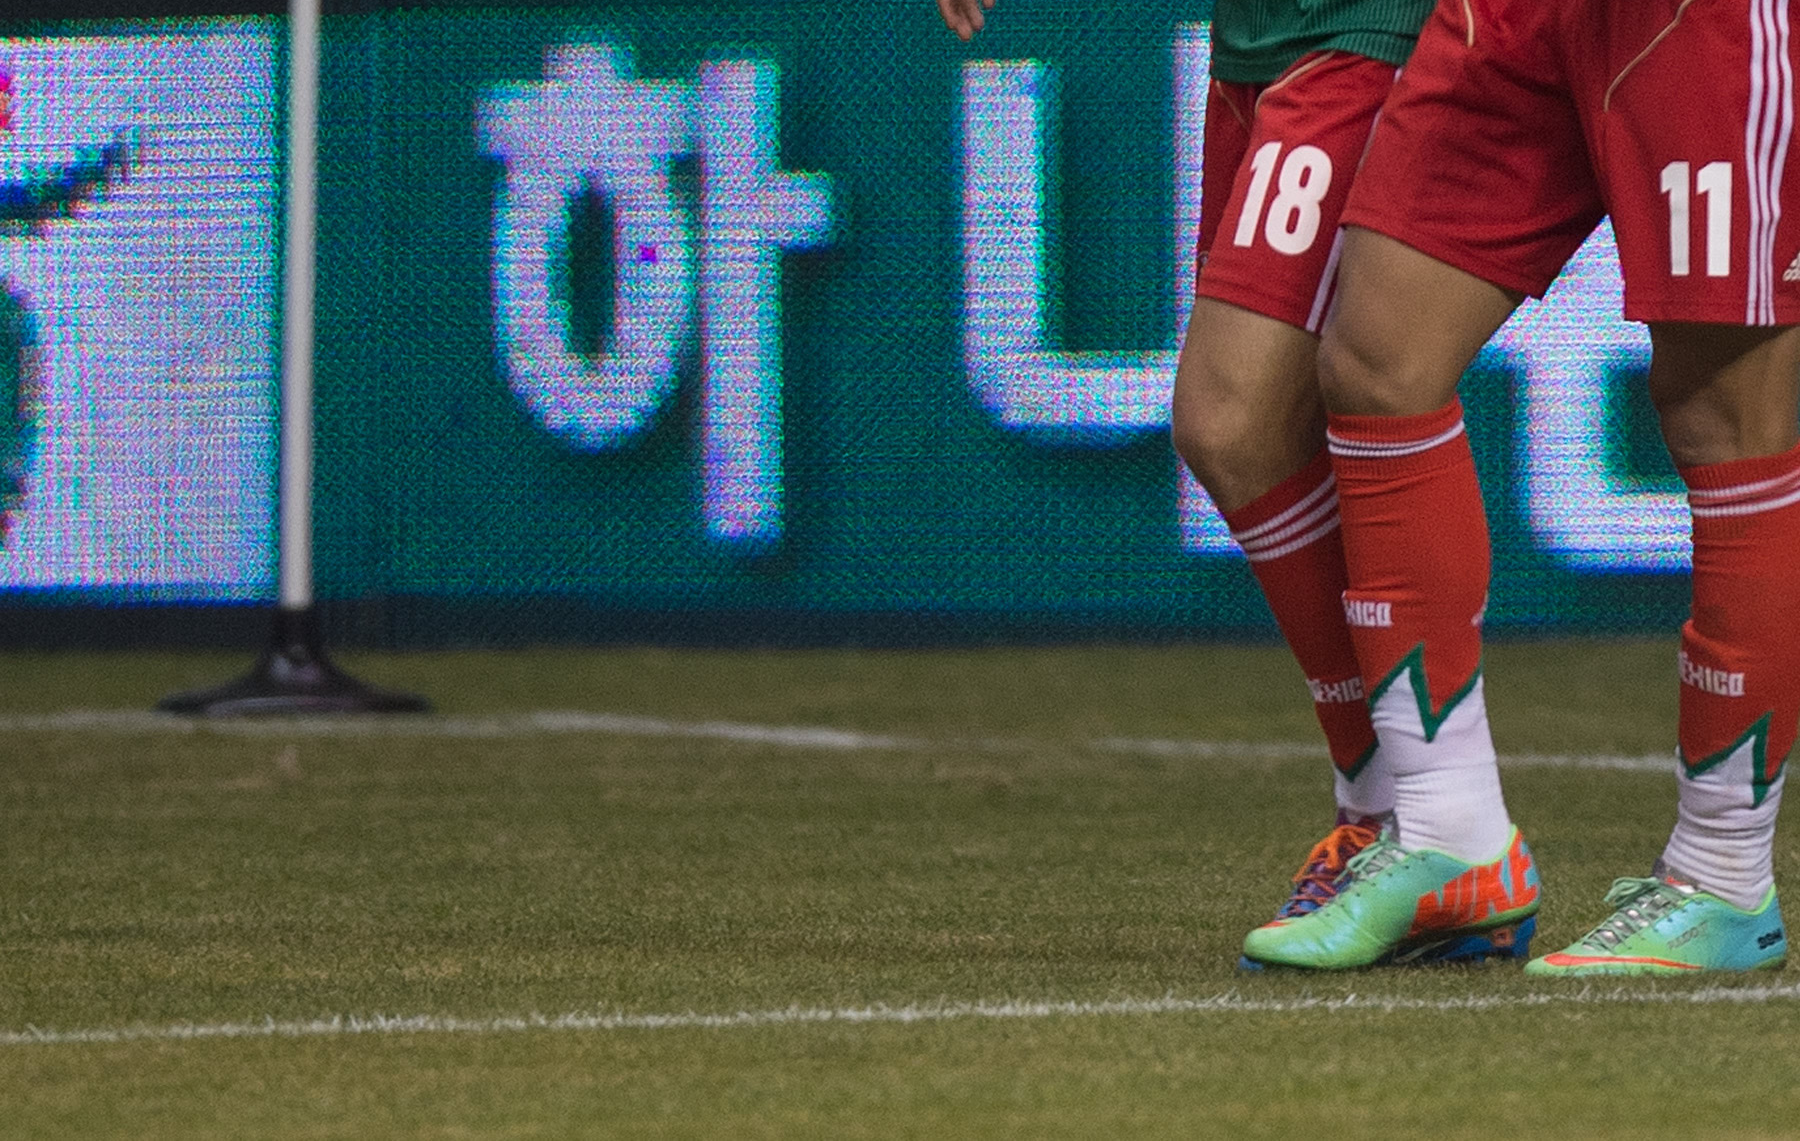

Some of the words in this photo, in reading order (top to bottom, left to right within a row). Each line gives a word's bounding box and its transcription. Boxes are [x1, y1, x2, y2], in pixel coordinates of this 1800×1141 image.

[1233, 141, 1332, 256] 18
[1659, 160, 1733, 277] 11
[1407, 830, 1539, 940] NIKE
